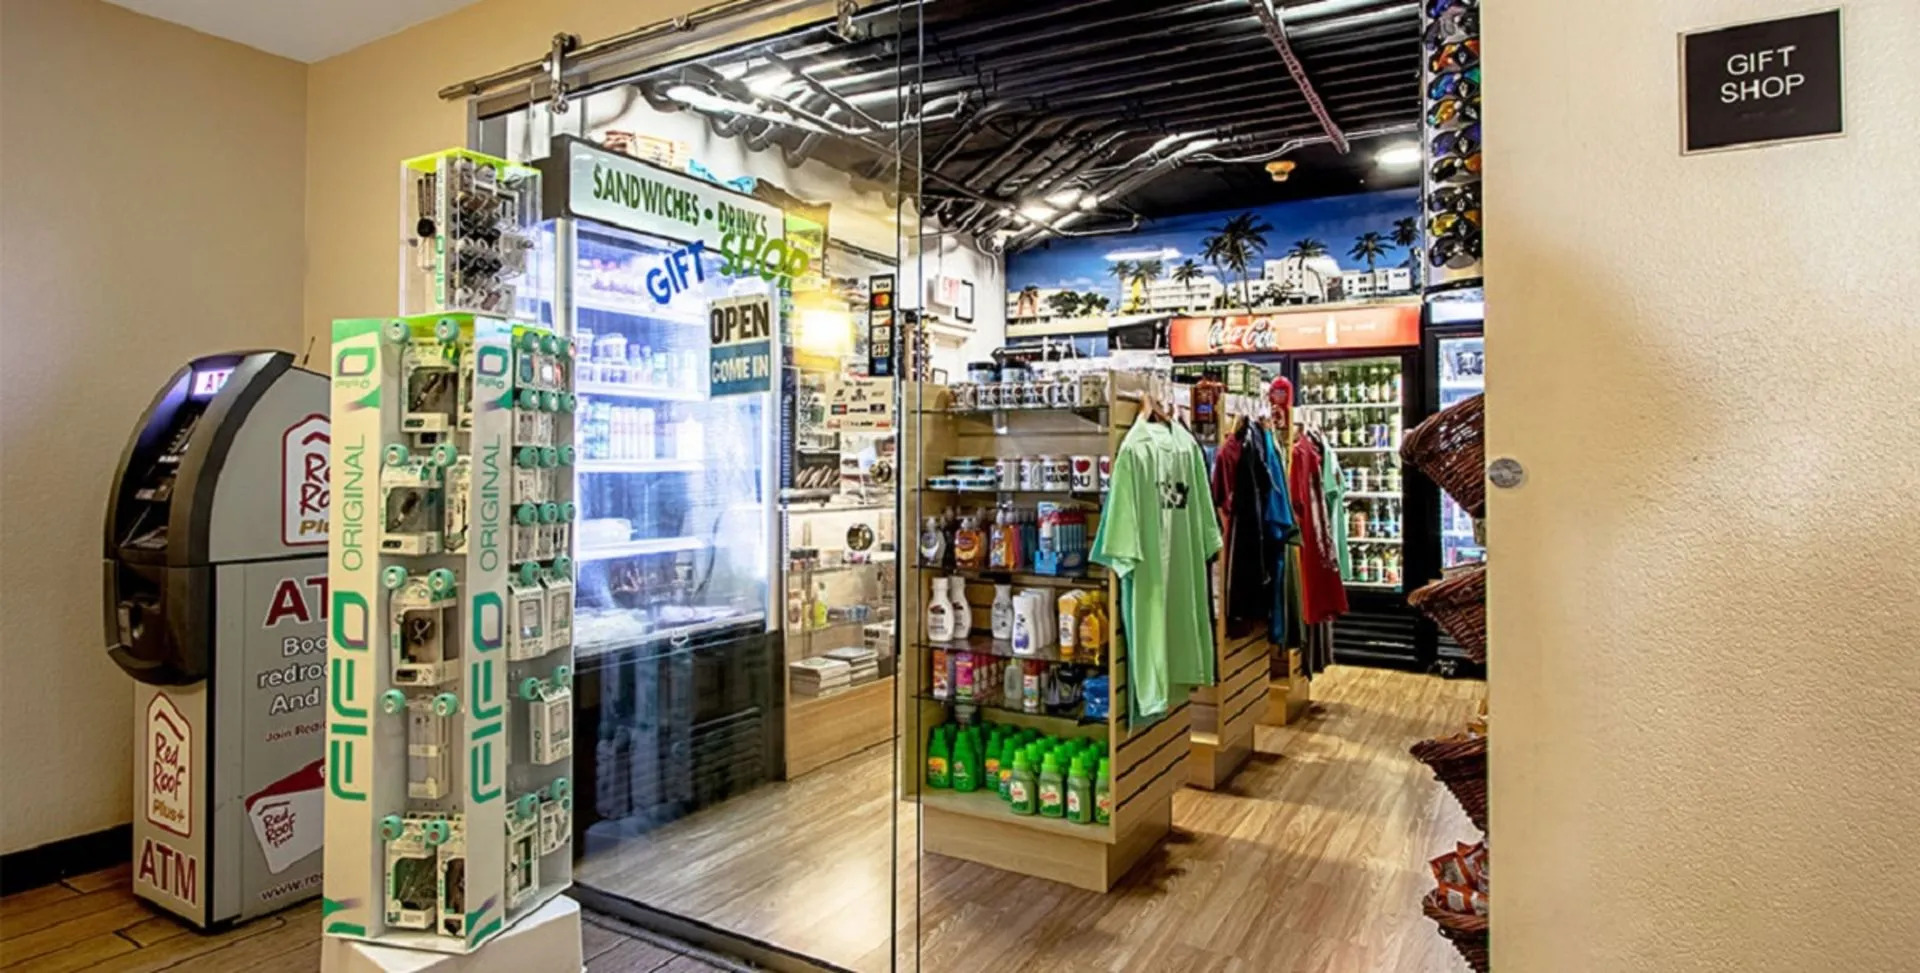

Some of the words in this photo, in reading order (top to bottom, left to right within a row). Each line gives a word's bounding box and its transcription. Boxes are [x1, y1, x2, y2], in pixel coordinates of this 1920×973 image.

[1727, 45, 1797, 75] GIFT
[1720, 73, 1805, 103] SHOP
[593, 163, 699, 227] SANDWICHES
[718, 201, 768, 240] DRINKS
[645, 239, 706, 305] GIFT
[718, 230, 810, 288] SHOP
[710, 301, 770, 344] OPEN
[711, 356, 751, 383] COME
[753, 354, 769, 377] IN
[342, 433, 366, 573] ORIGINAL
[479, 433, 501, 573] ORIGINAL
[270, 687, 321, 717] And
[330, 590, 370, 802] FIFO
[471, 590, 504, 804] FIFO
[155, 732, 179, 766] Red
[265, 730, 292, 742] Join
[153, 761, 186, 801] Roof
[153, 799, 185, 822] Plus+
[263, 807, 289, 828] Red
[265, 813, 296, 845] Roof
[139, 839, 197, 906] ATM
